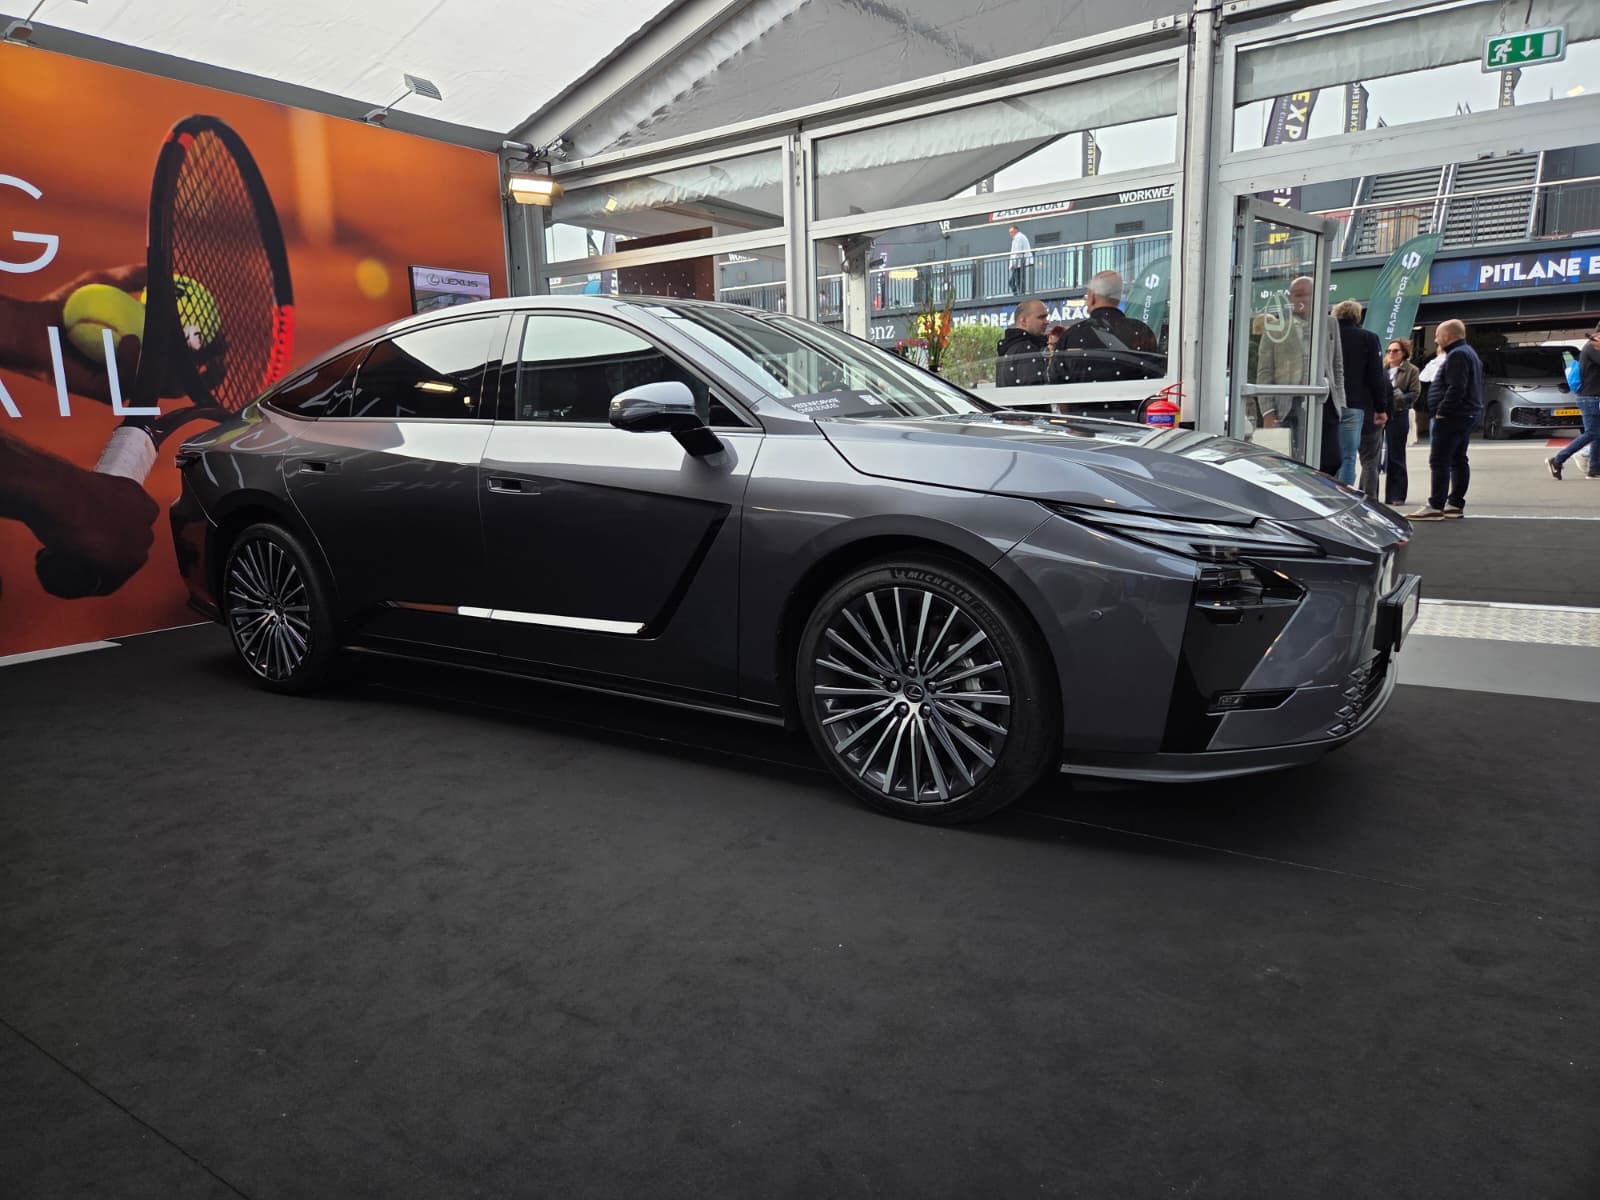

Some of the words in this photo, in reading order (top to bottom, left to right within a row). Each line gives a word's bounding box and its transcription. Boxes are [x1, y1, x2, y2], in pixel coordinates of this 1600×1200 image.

[1281, 91, 1310, 144] EXP
[441, 276, 479, 288] LEXUS
[1480, 257, 1582, 284] PITLANE
[1385, 276, 1409, 340] LEAPMOTOR
[907, 570, 972, 602] MICHELIN
